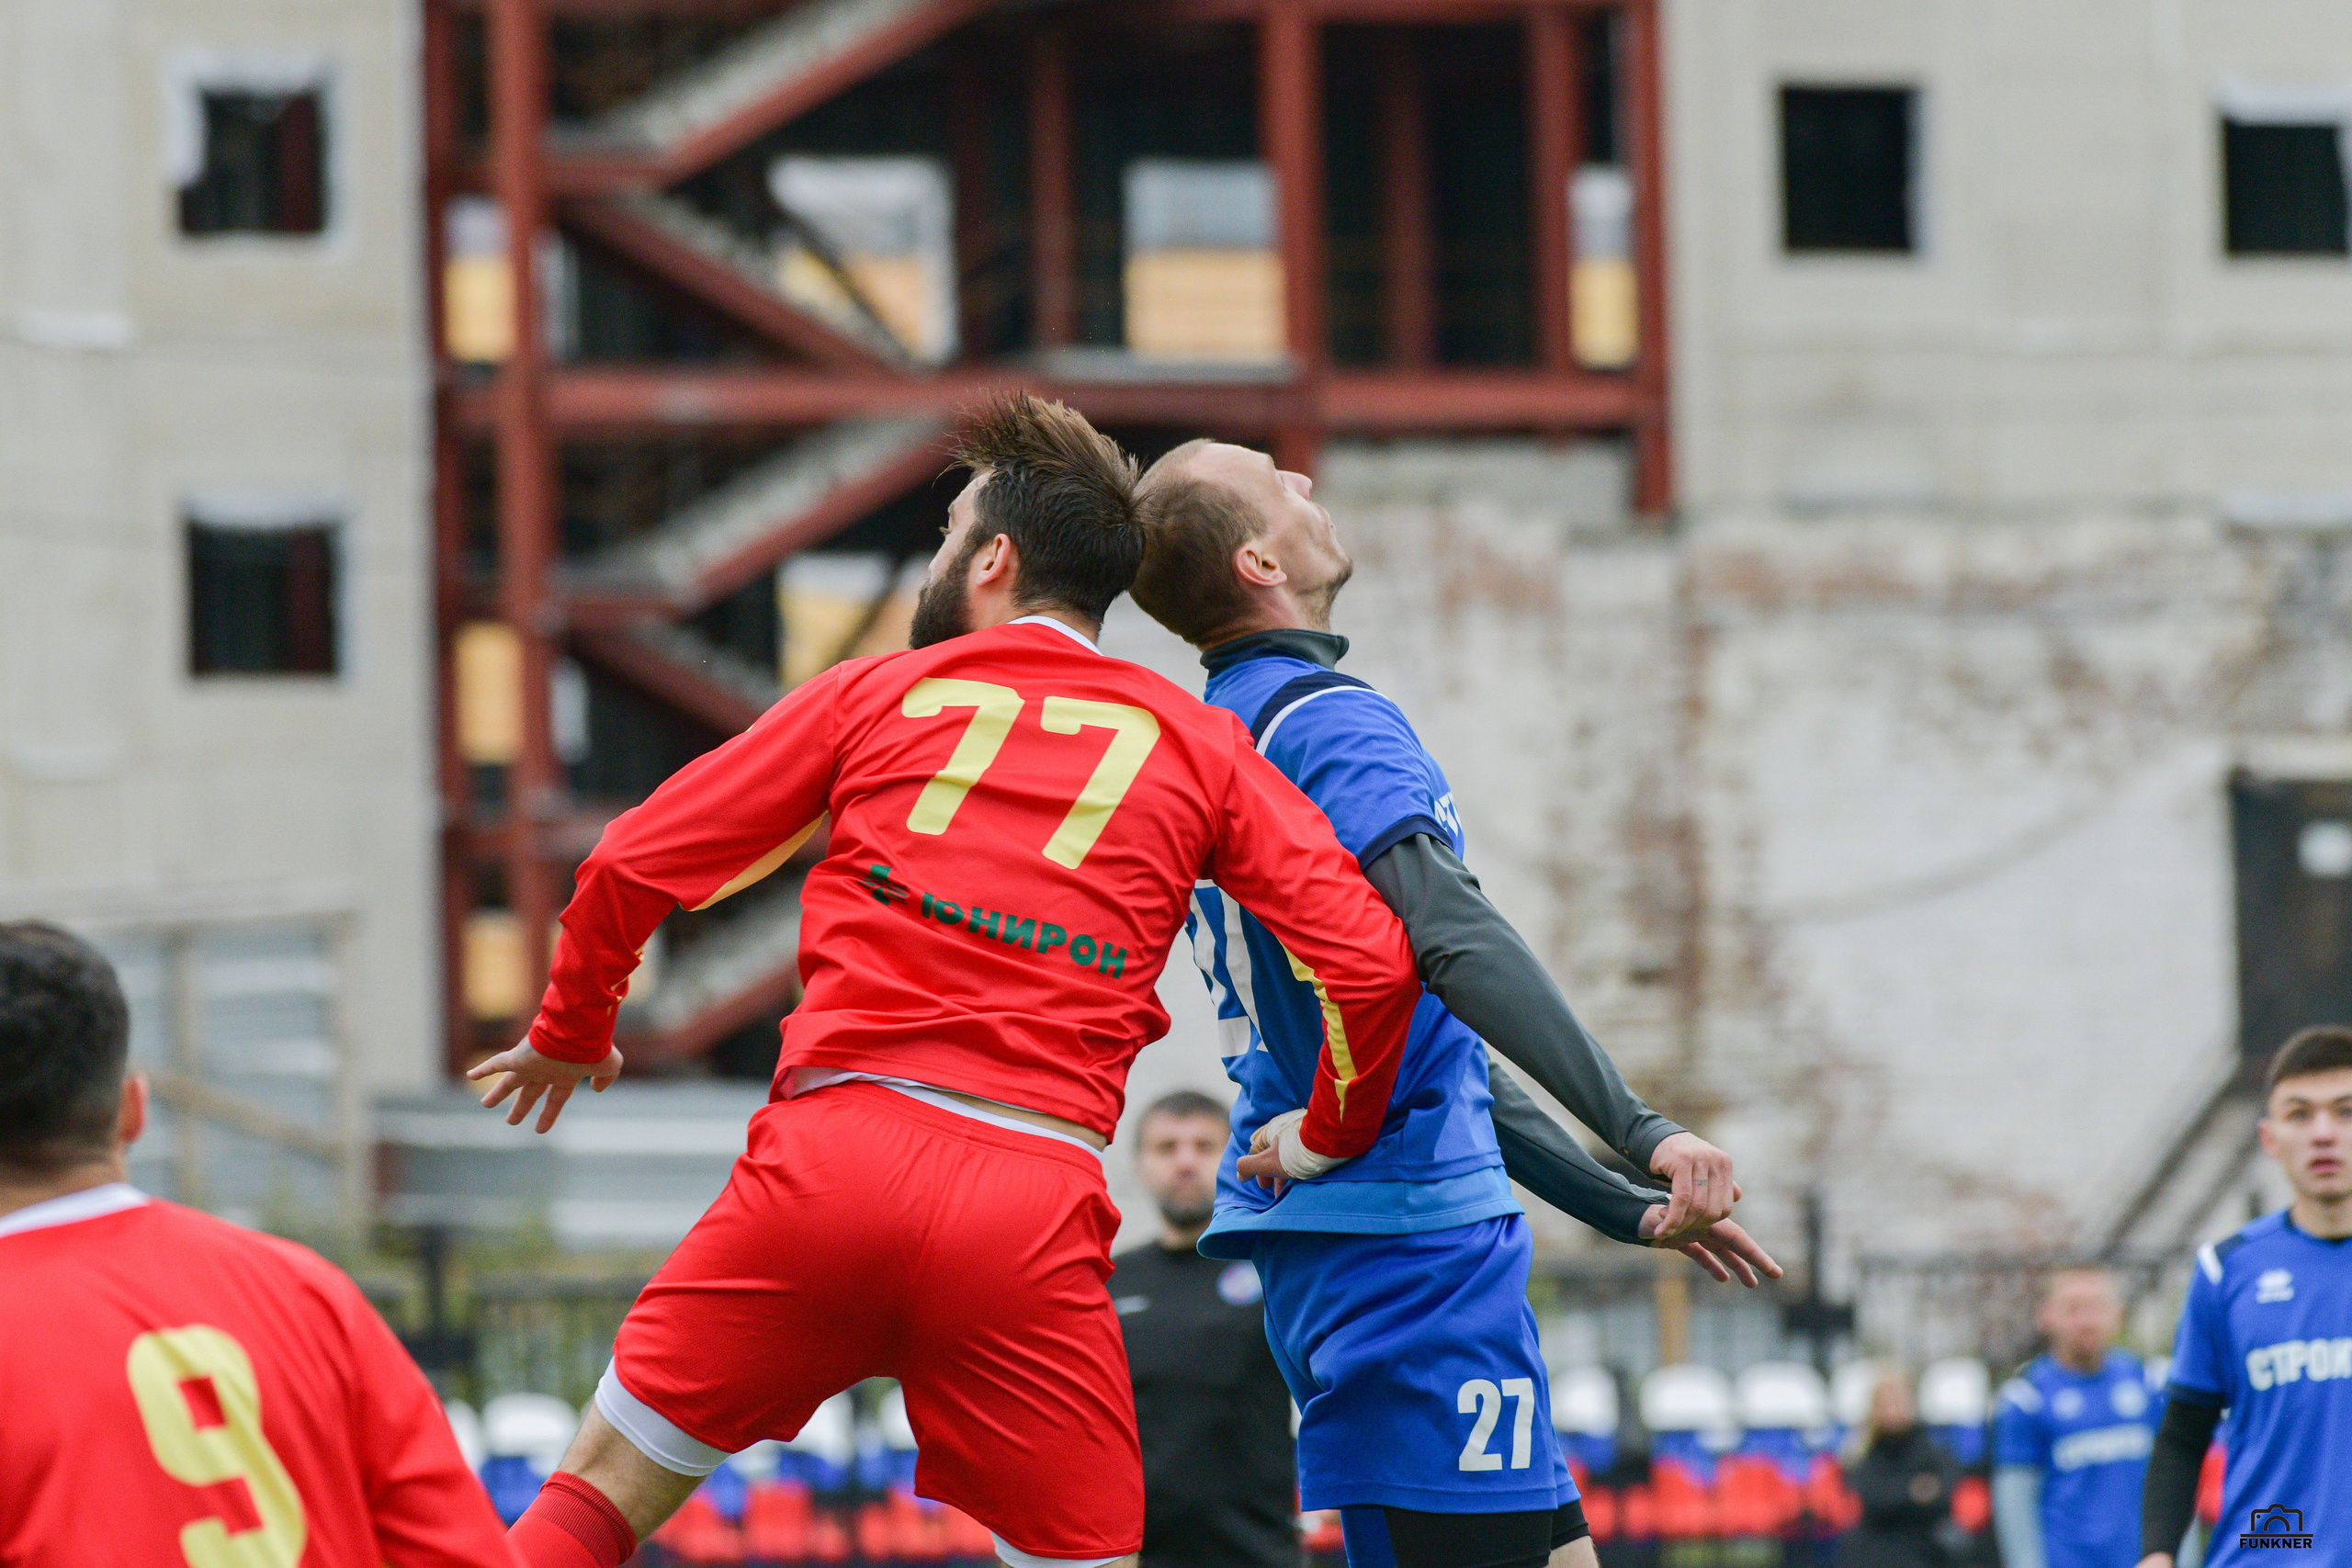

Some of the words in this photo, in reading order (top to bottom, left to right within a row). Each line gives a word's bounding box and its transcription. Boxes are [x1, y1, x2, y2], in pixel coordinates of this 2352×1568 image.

[901, 677, 1160, 869] 77
[921, 891, 1128, 979] ЮНИРОН
[2245, 1338, 2352, 1391] СТРОИ
[126, 1323, 307, 1568] 9
[1457, 1378, 1534, 1472] 27
